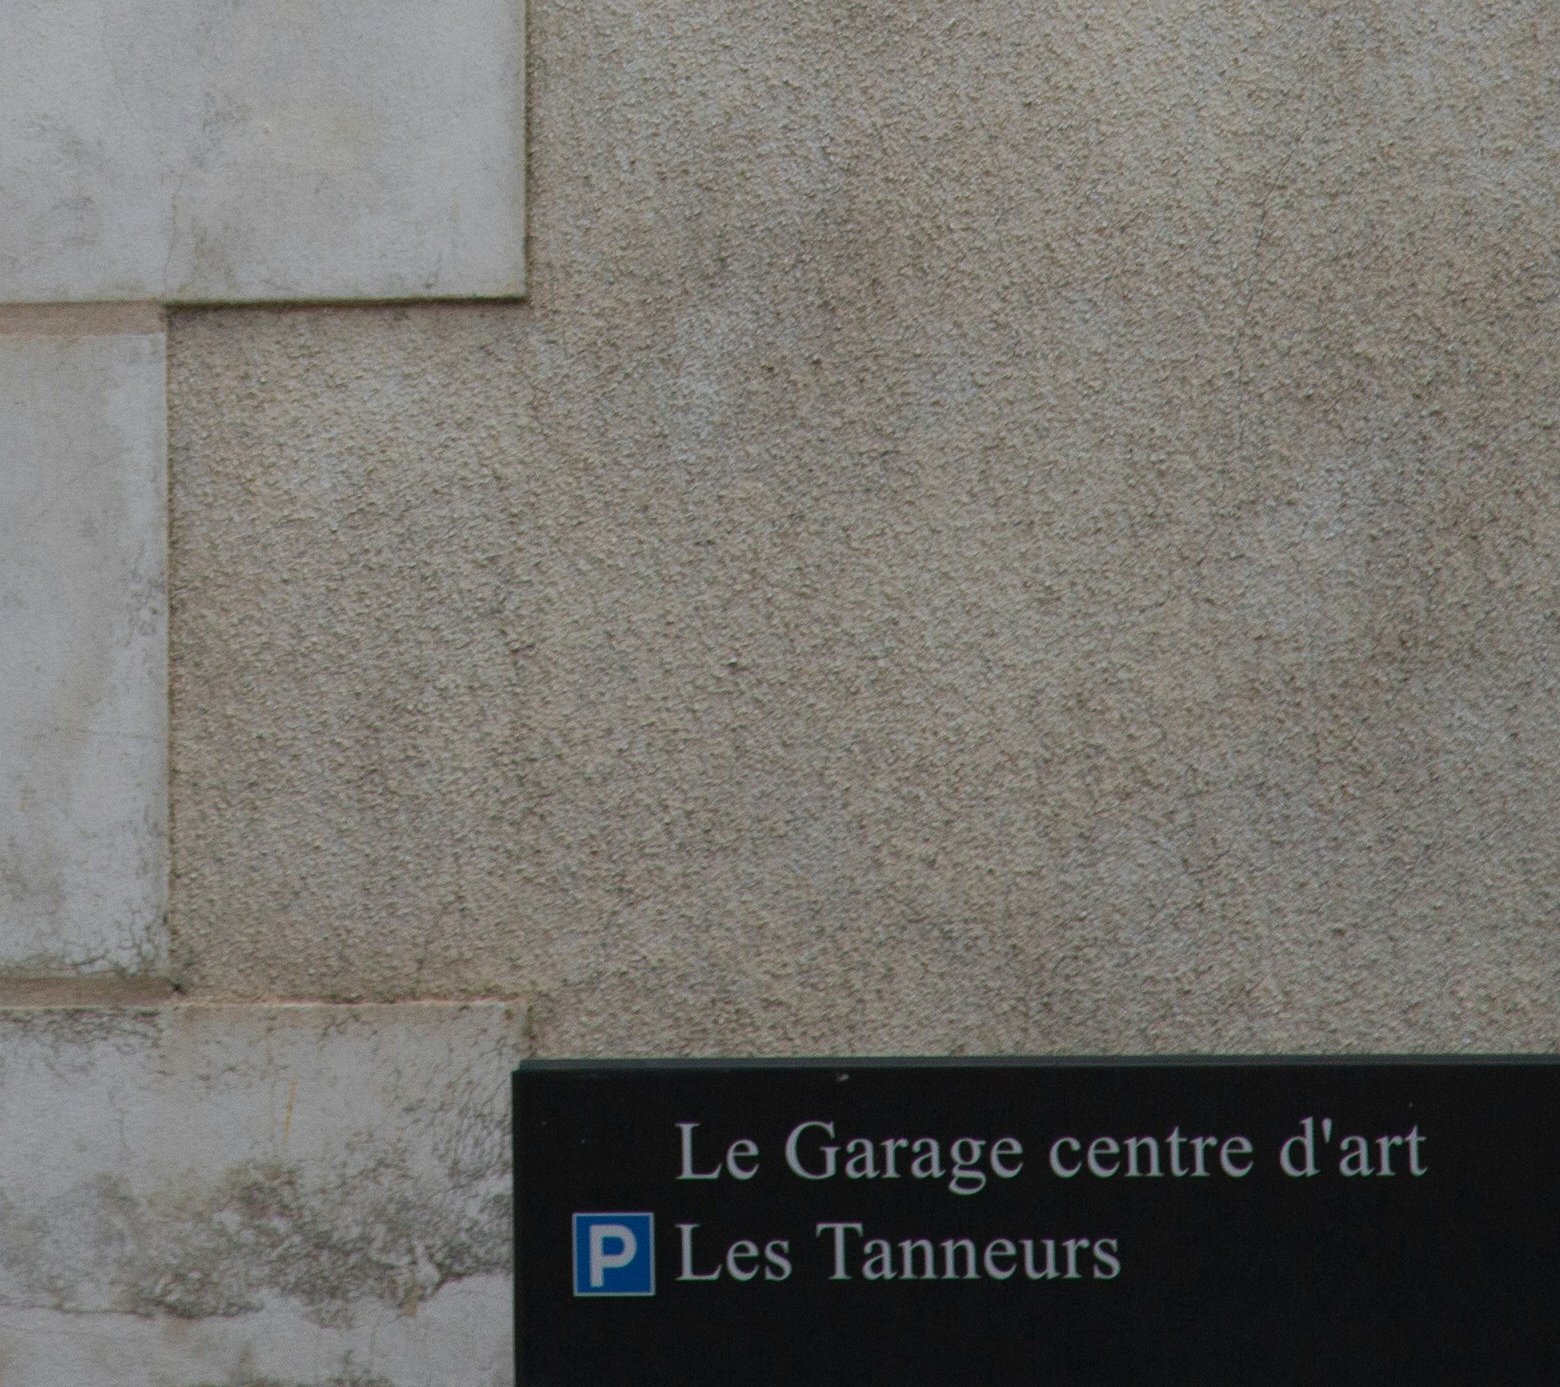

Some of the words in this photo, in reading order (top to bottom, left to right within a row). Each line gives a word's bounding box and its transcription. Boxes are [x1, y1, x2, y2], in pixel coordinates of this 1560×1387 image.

[675, 1122, 760, 1181] Le
[784, 1120, 1025, 1196] Garage
[1048, 1125, 1255, 1178] centre
[1279, 1116, 1429, 1178] d'art
[588, 1223, 639, 1289] P
[675, 1223, 793, 1282] Les
[815, 1222, 1122, 1281] Tanneurs
